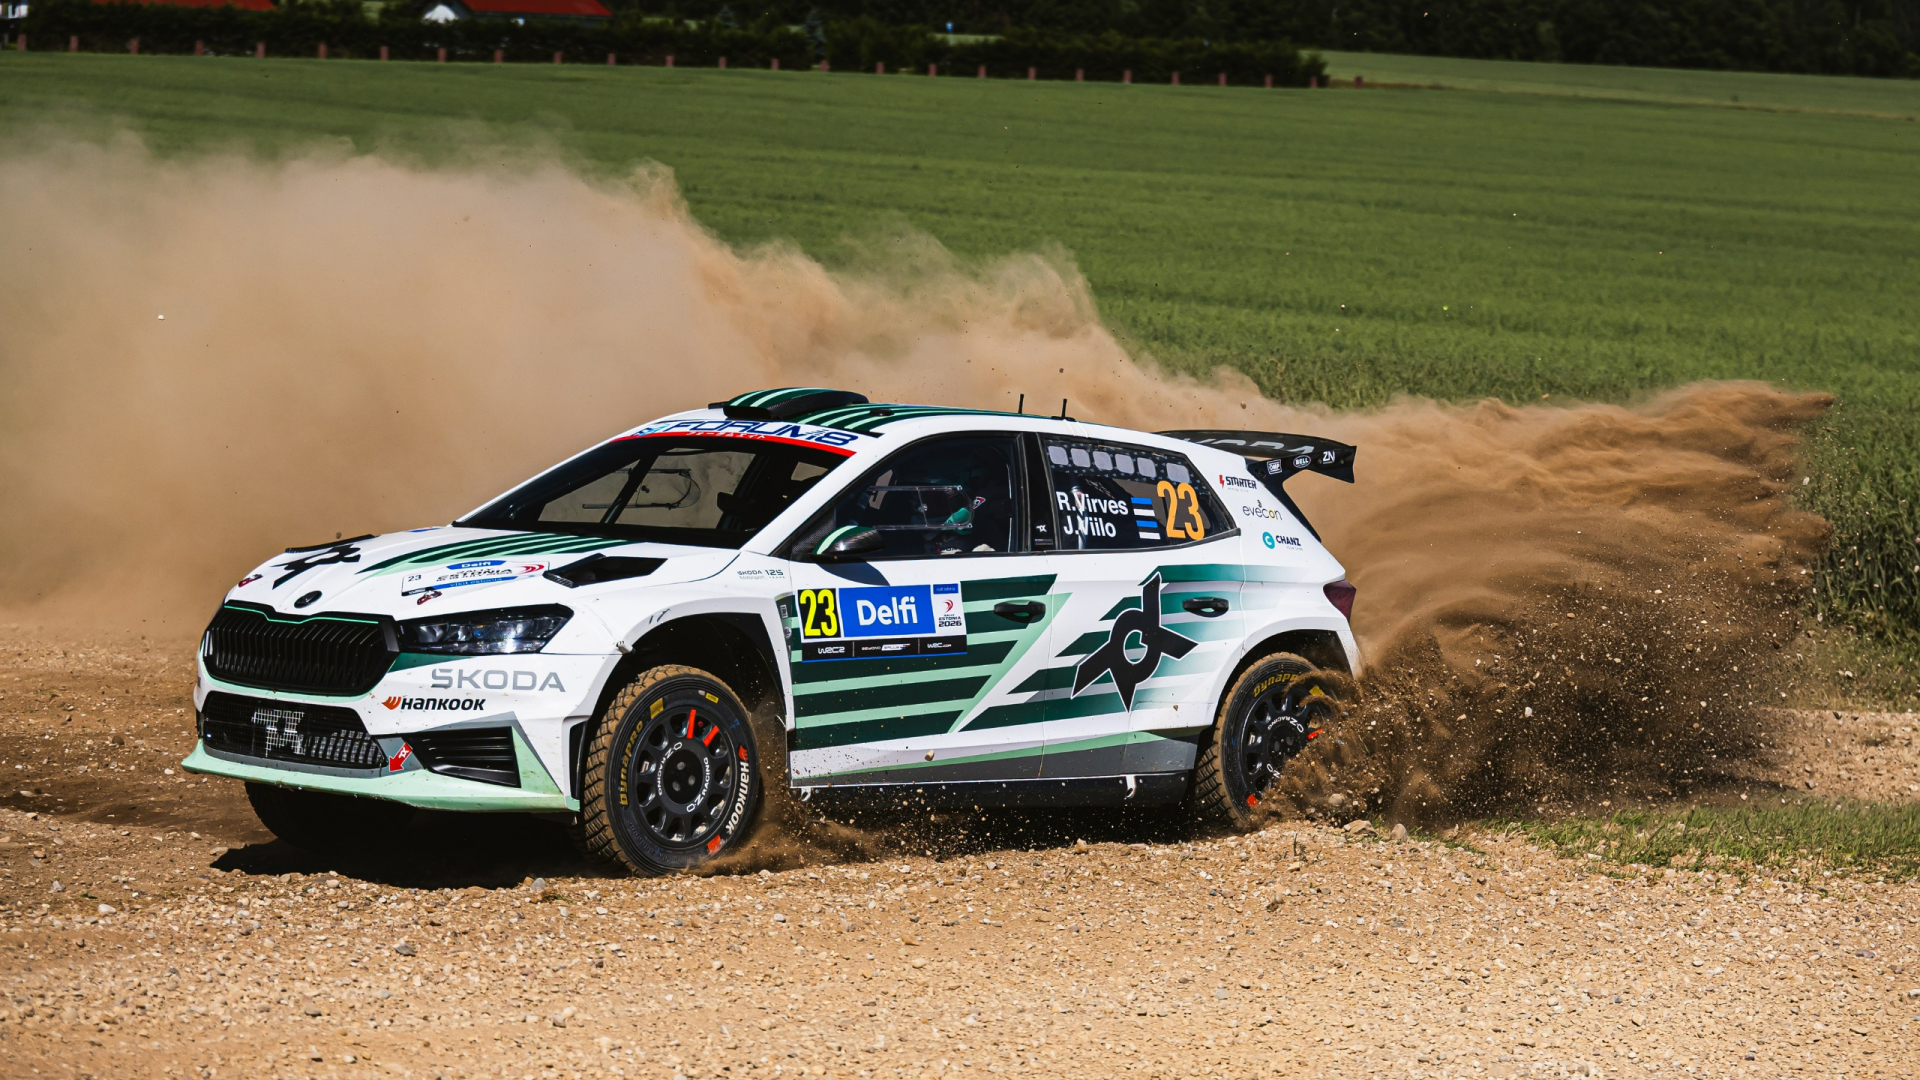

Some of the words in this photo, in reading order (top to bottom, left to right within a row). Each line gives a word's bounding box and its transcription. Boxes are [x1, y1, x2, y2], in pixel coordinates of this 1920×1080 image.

[1295, 457, 1309, 466] BELL
[1156, 481, 1205, 541] 23
[1242, 505, 1283, 521] evecon
[1275, 534, 1302, 547] CHANZ
[407, 574, 422, 582] 23
[799, 588, 838, 637] 23
[856, 596, 918, 627] Delfi
[938, 620, 962, 628] 2026
